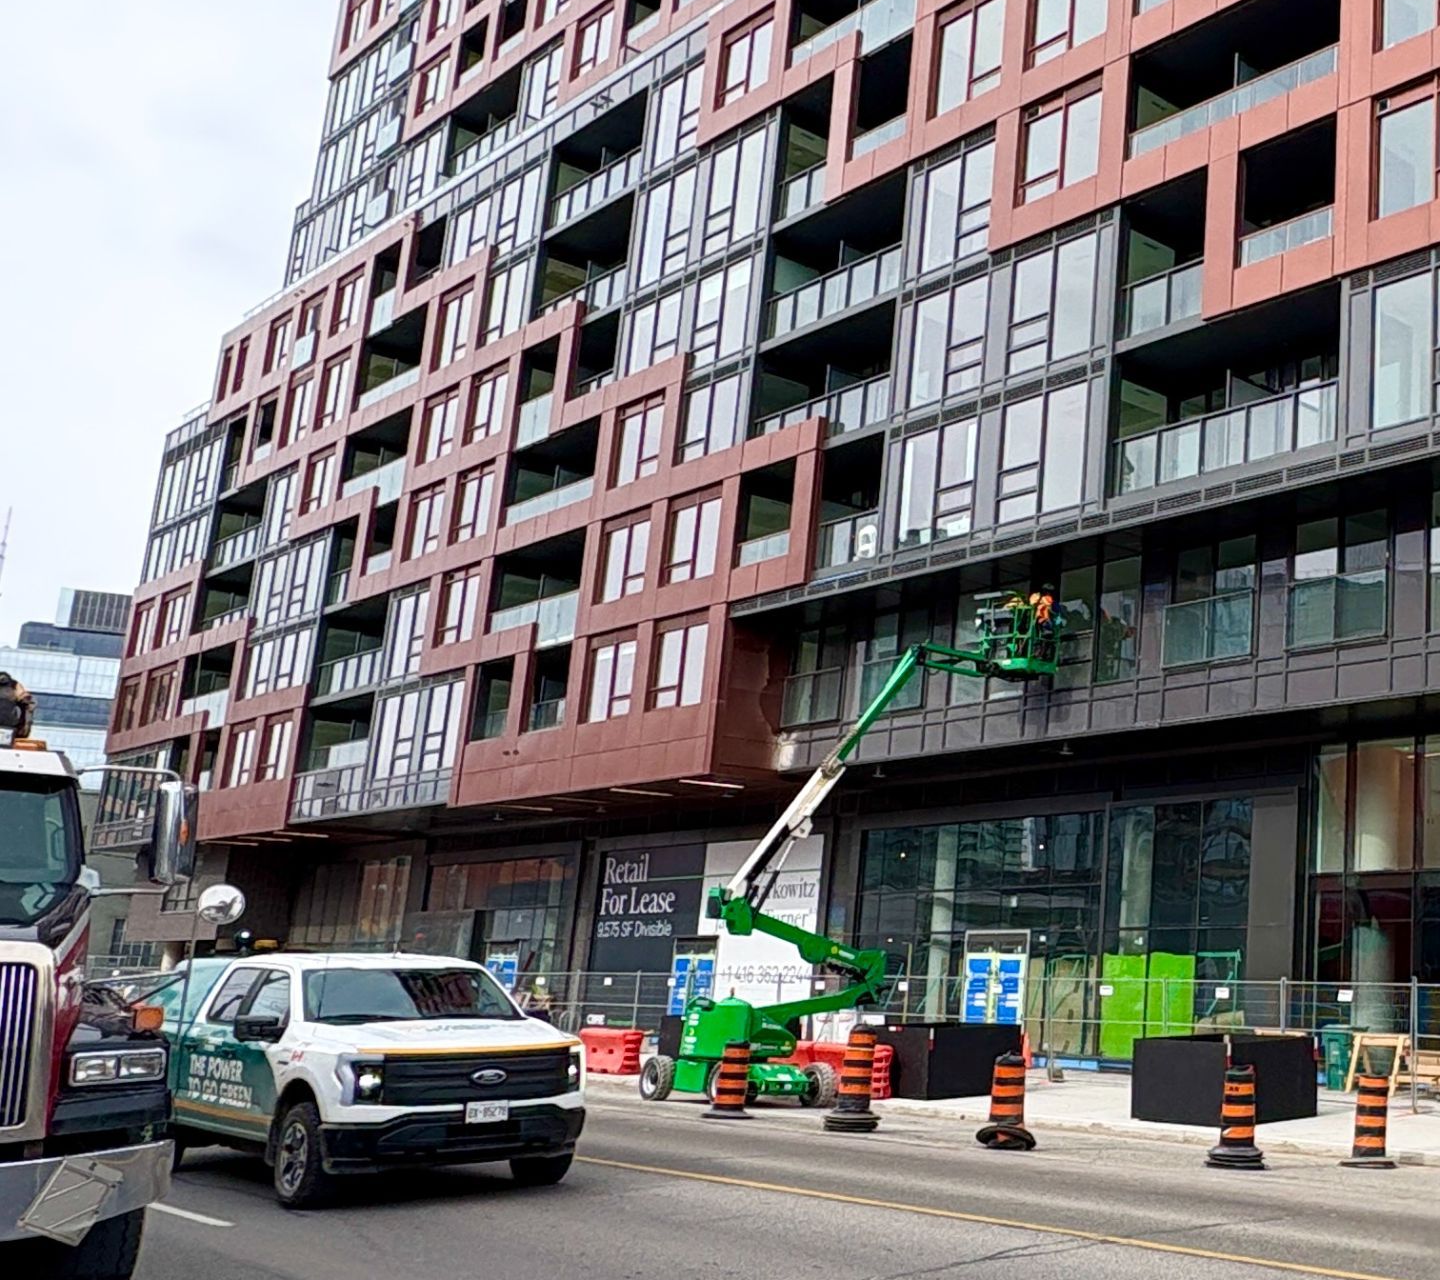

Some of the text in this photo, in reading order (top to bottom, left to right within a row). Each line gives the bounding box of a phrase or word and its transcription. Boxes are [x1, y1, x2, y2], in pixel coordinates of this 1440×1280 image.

[603, 852, 650, 885] Retail
[600, 886, 676, 915] For Lease
[620, 920, 634, 938] SF
[633, 919, 673, 937] Divisible
[734, 965, 754, 984] 416
[189, 1053, 244, 1083] THE POWER
[187, 1076, 201, 1099] TO
[218, 1081, 253, 1110] GREEN
